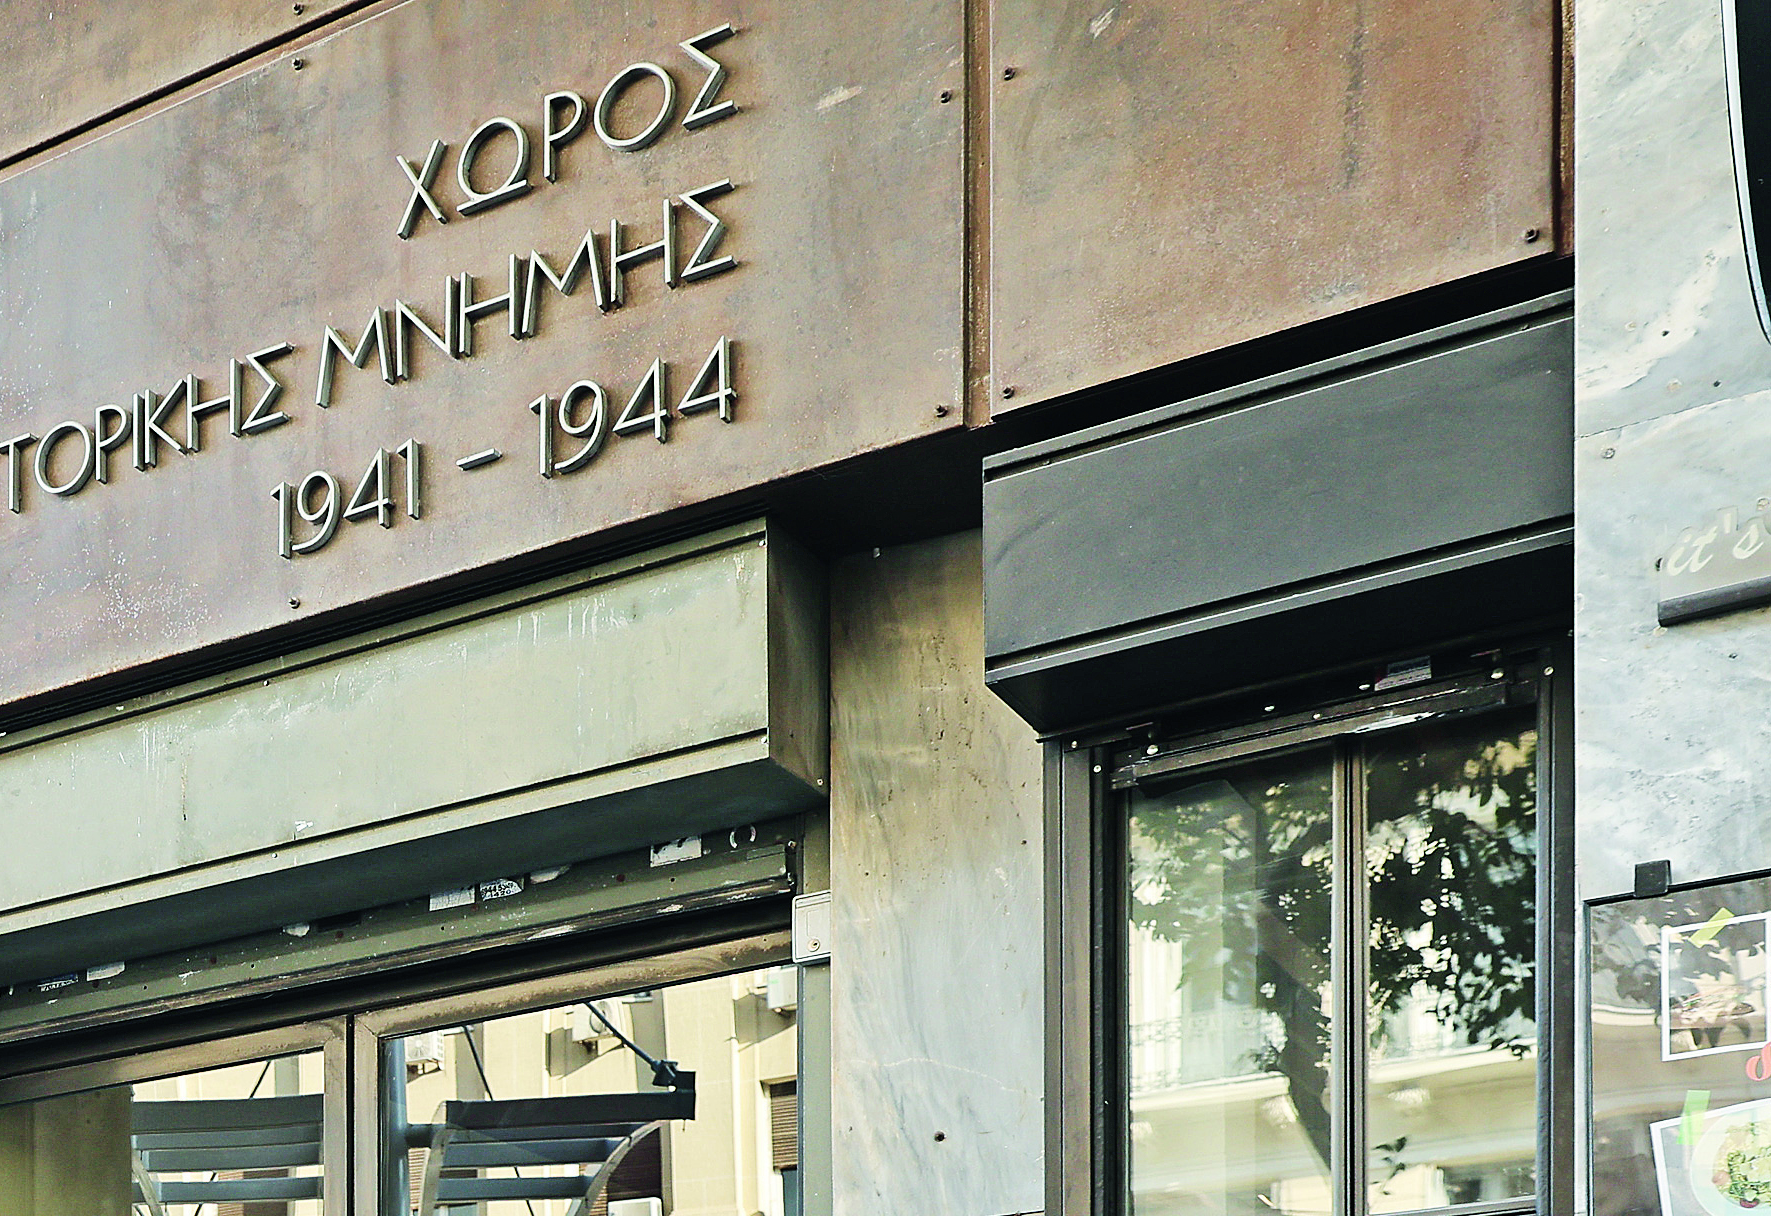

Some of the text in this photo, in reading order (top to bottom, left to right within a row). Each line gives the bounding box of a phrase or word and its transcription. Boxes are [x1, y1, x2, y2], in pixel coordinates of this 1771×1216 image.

[395, 23, 739, 240] ΧΩΡΟΣ
[315, 178, 739, 409] ΜΝΗΜΗΣ
[269, 438, 421, 560] 1941
[529, 335, 737, 478] 1944
